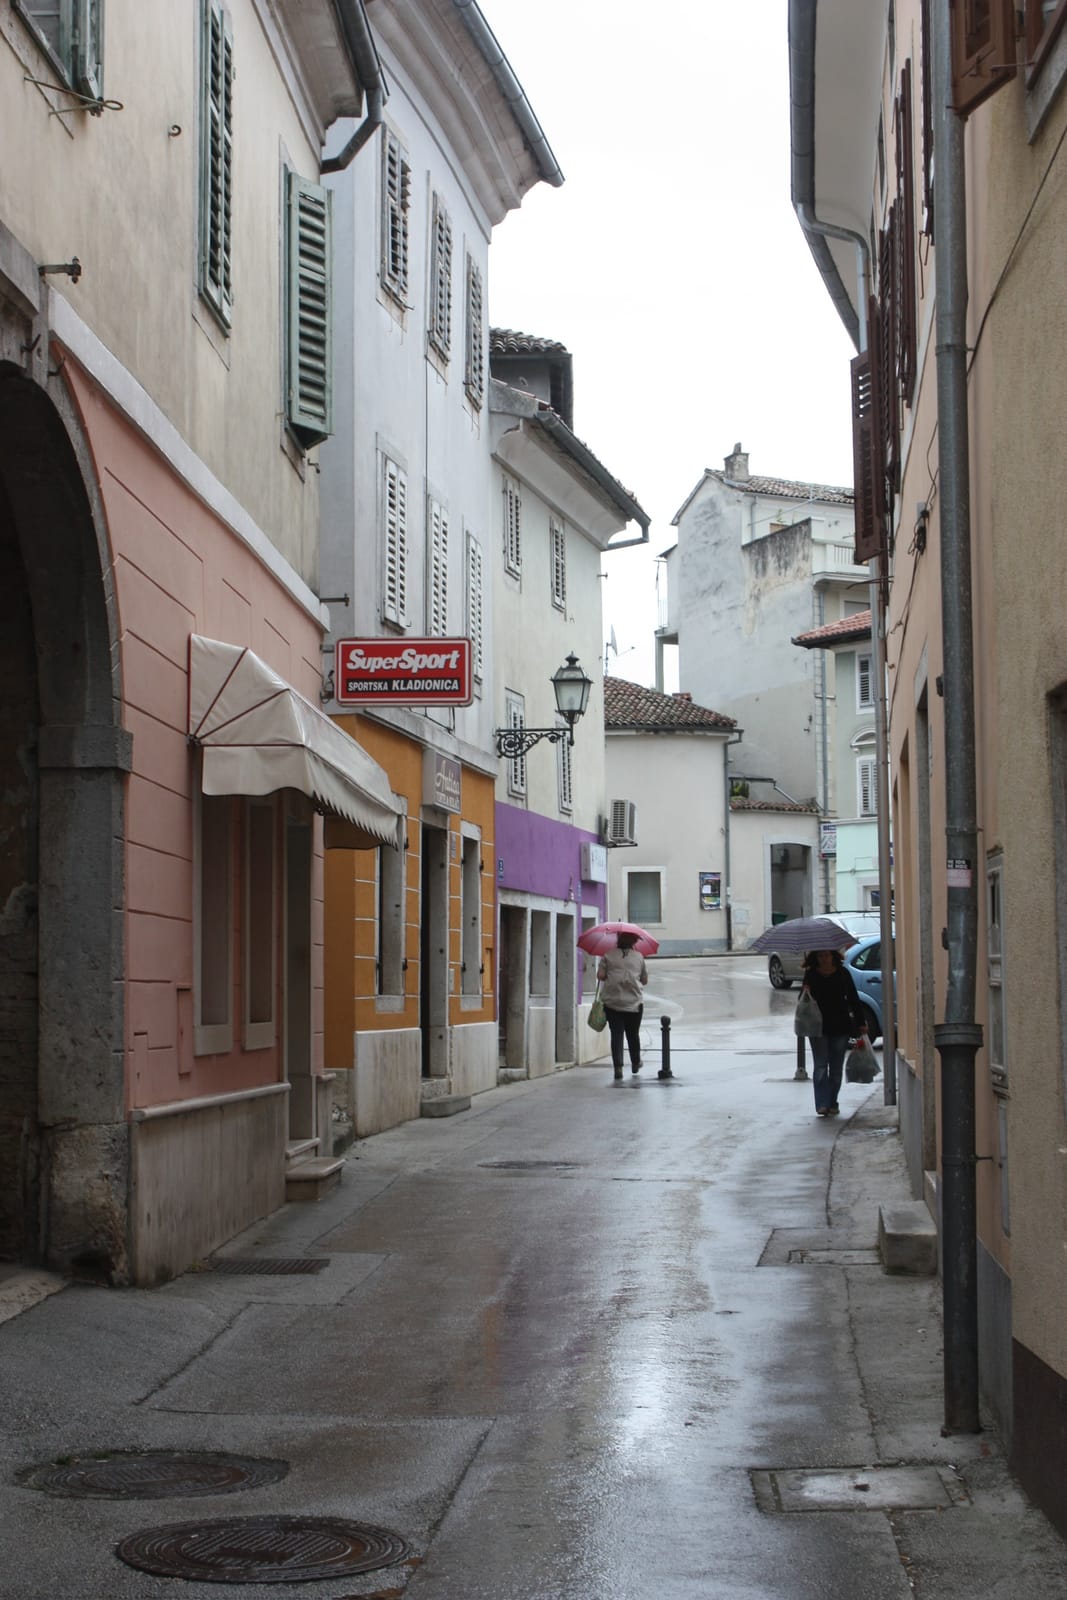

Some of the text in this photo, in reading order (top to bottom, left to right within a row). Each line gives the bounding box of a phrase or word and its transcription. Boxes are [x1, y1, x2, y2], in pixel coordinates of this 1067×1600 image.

[346, 648, 460, 673] SuperSport
[348, 679, 459, 691] SPORTSKA KLADIONICA
